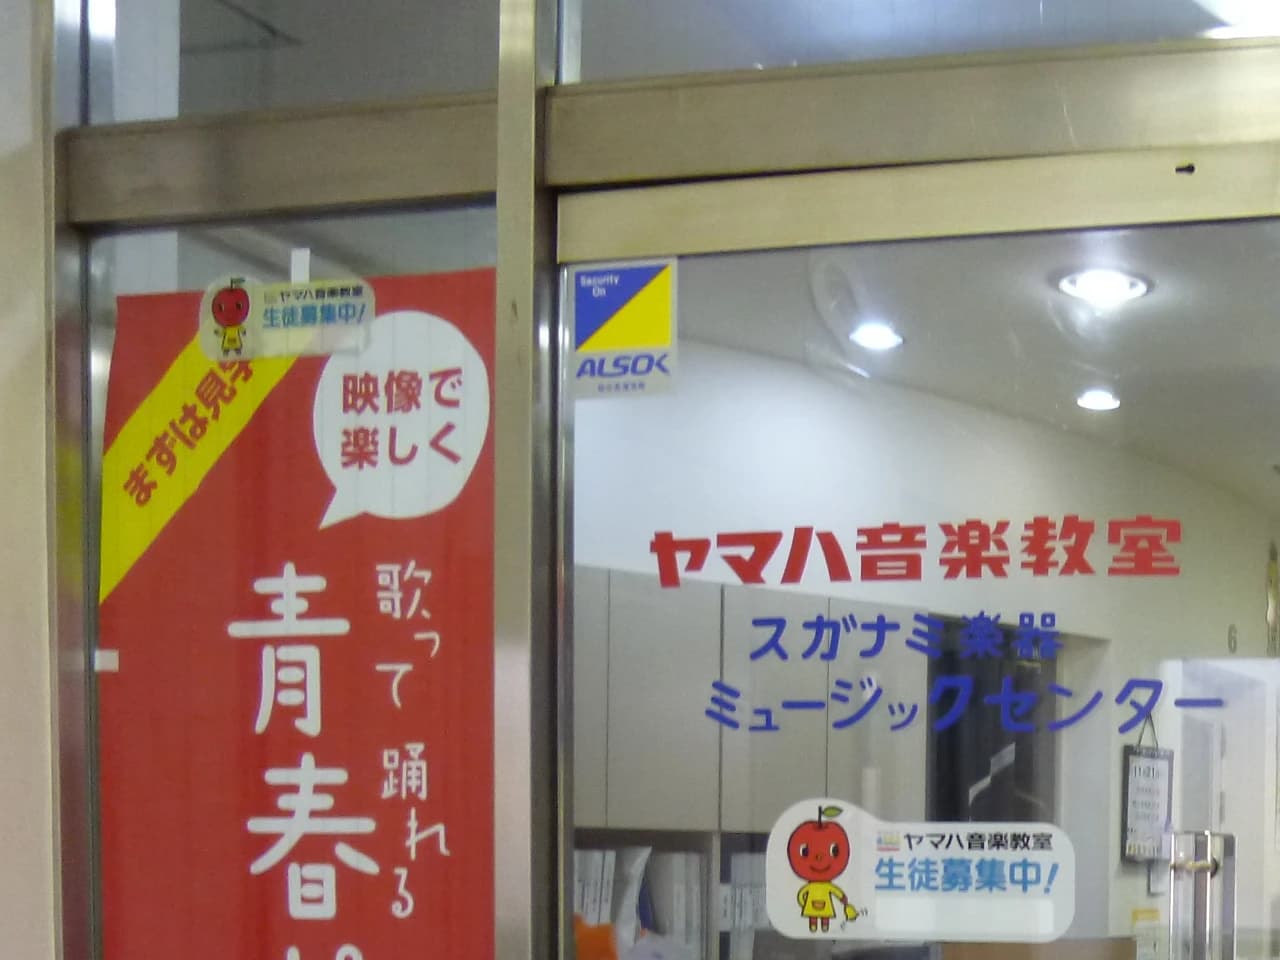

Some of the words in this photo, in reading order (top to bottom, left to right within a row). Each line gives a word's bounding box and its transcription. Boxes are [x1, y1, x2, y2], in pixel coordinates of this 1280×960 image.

[341, 366, 464, 415] 映像で
[575, 352, 671, 379] ALSOK
[340, 422, 463, 471] 楽しく
[649, 513, 1182, 589] ヤマハ音楽教室
[375, 559, 441, 711] 歌って
[748, 609, 1066, 662] スガナミ楽器
[704, 674, 1227, 734] ミュージックセンター
[381, 742, 451, 919] 踊れる
[903, 831, 1054, 852] ヤマハ音楽教室
